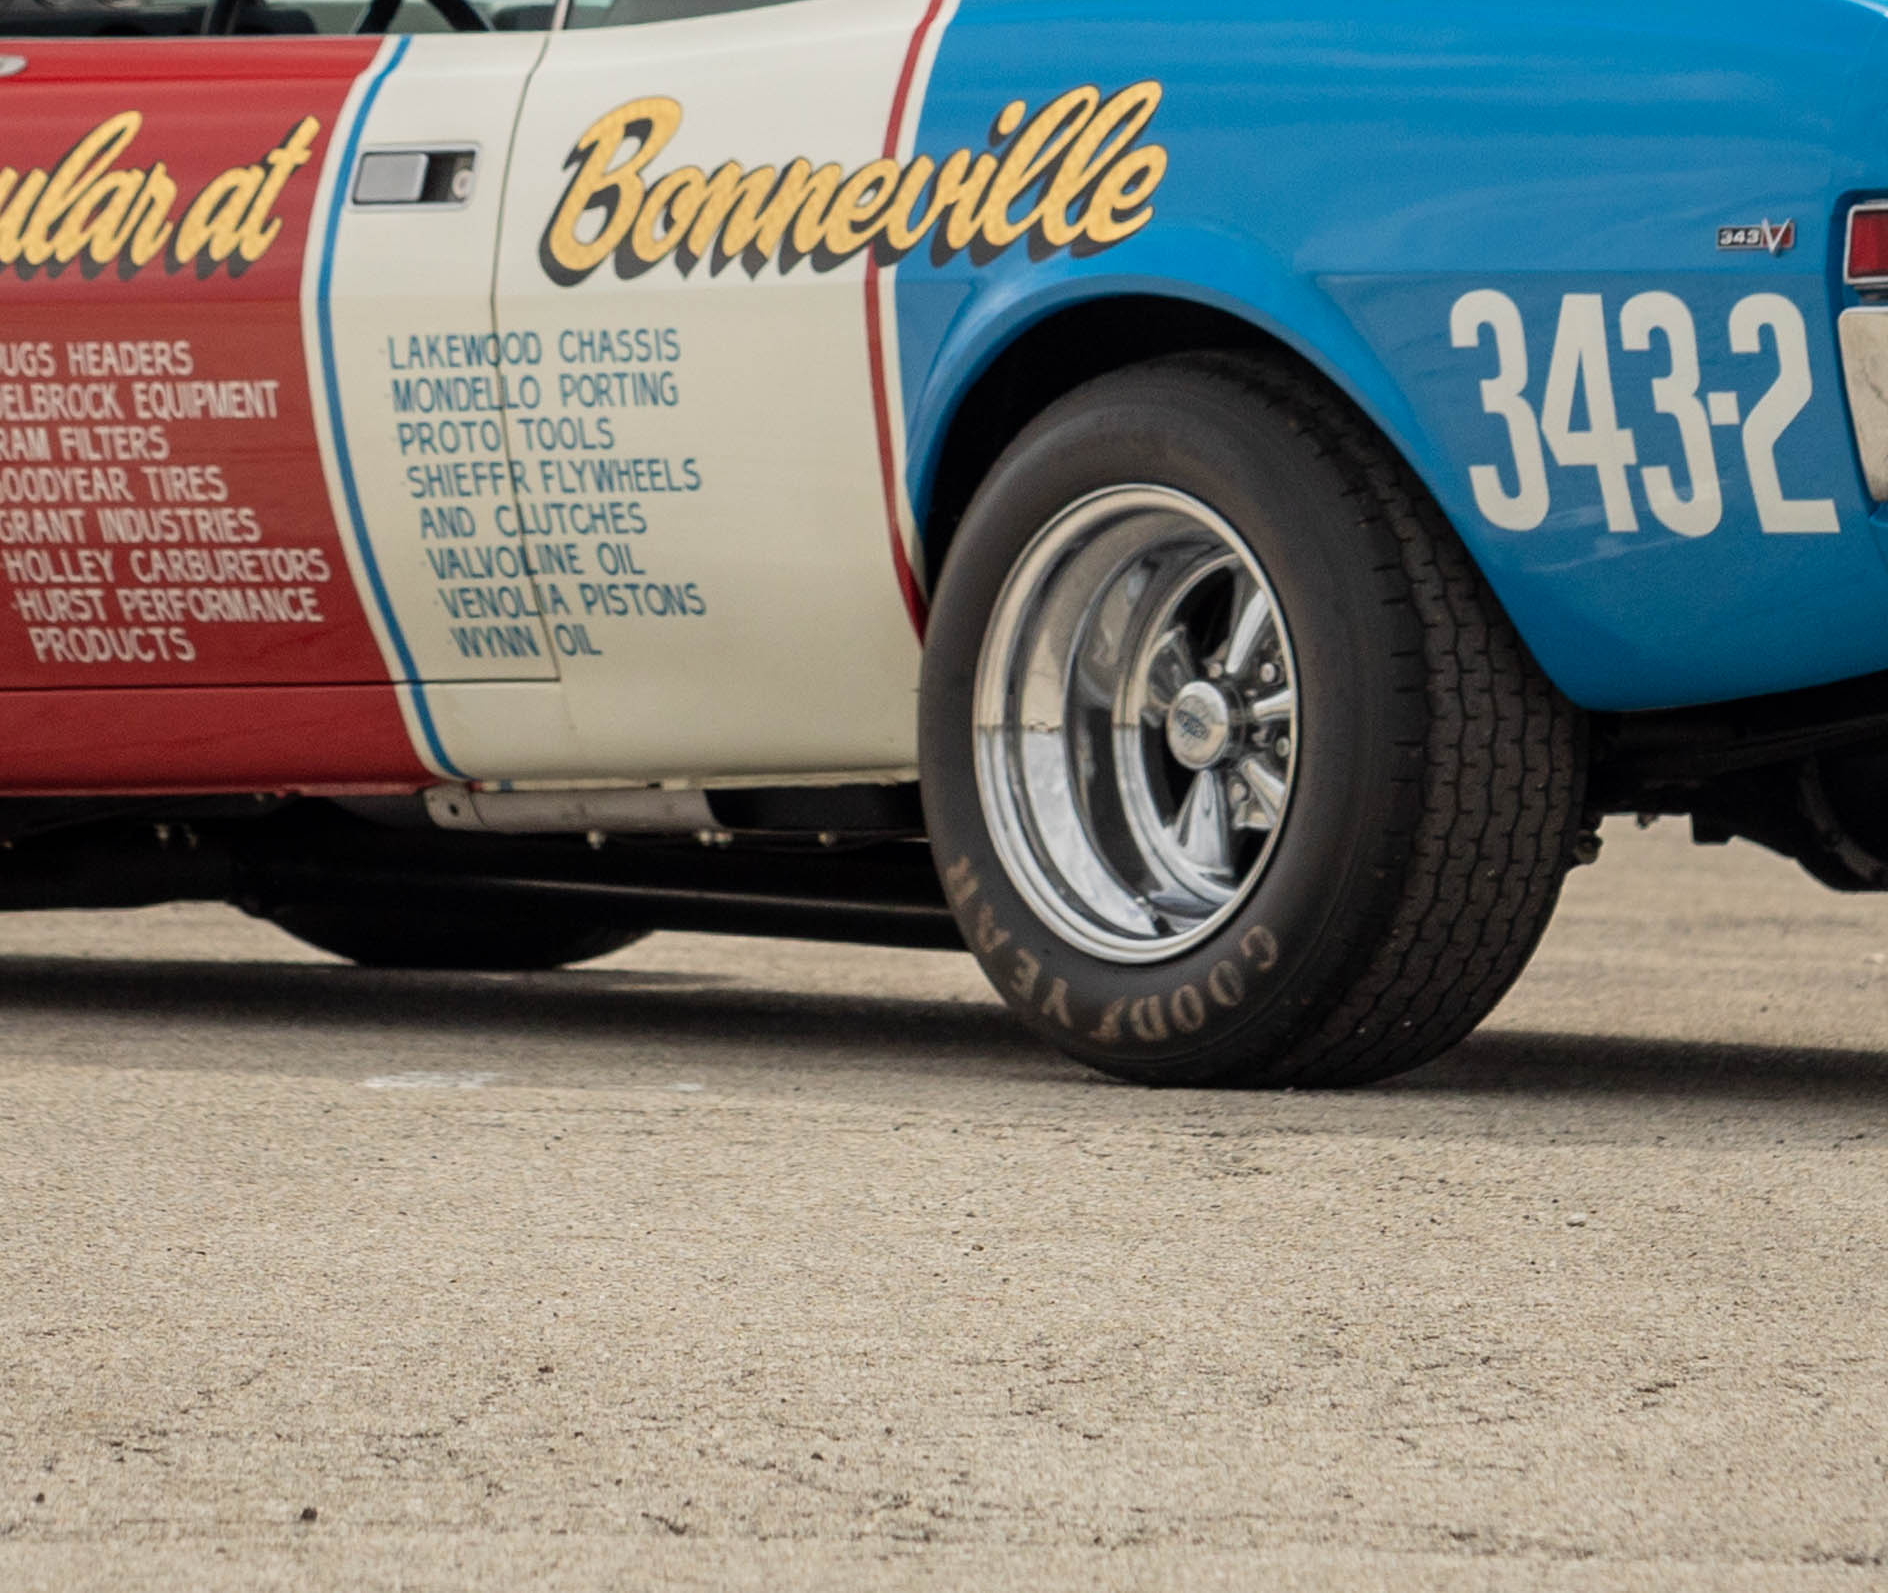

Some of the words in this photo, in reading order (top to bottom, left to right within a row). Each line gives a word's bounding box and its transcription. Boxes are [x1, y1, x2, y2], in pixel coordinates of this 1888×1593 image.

[174, 115, 320, 279] at
[539, 80, 1168, 287] Bonneville
[66, 340, 193, 376] HEADERS
[388, 332, 542, 370] LAKEWOOD
[559, 328, 681, 363] CHASSIS
[132, 380, 279, 421] EQUIPMENT
[392, 375, 541, 413] MONDELLO
[559, 371, 679, 407] PORTING
[1450, 289, 1840, 538] 343-2
[58, 425, 169, 461] FILTERS
[397, 420, 502, 455] PROTO
[518, 417, 615, 452] TOOLS
[141, 465, 228, 502] TIRES
[539, 458, 701, 494] FLYWHEELS
[98, 506, 262, 543] INDUSTRIES
[421, 506, 476, 540] AND
[495, 502, 647, 538] CLUTCHES
[1, 549, 115, 584] HOLLEY
[129, 547, 330, 582] CARBURETORS
[426, 544, 584, 580] VALVOLINE
[596, 542, 646, 576] OIL
[15, 588, 108, 622] HURST
[116, 587, 325, 623] PERFORMANCE
[439, 584, 569, 619] VENOLIA
[578, 582, 706, 617] PISTONS
[28, 627, 196, 663] PRODUCTS
[450, 625, 542, 658] WYNN
[554, 623, 602, 656] OIL
